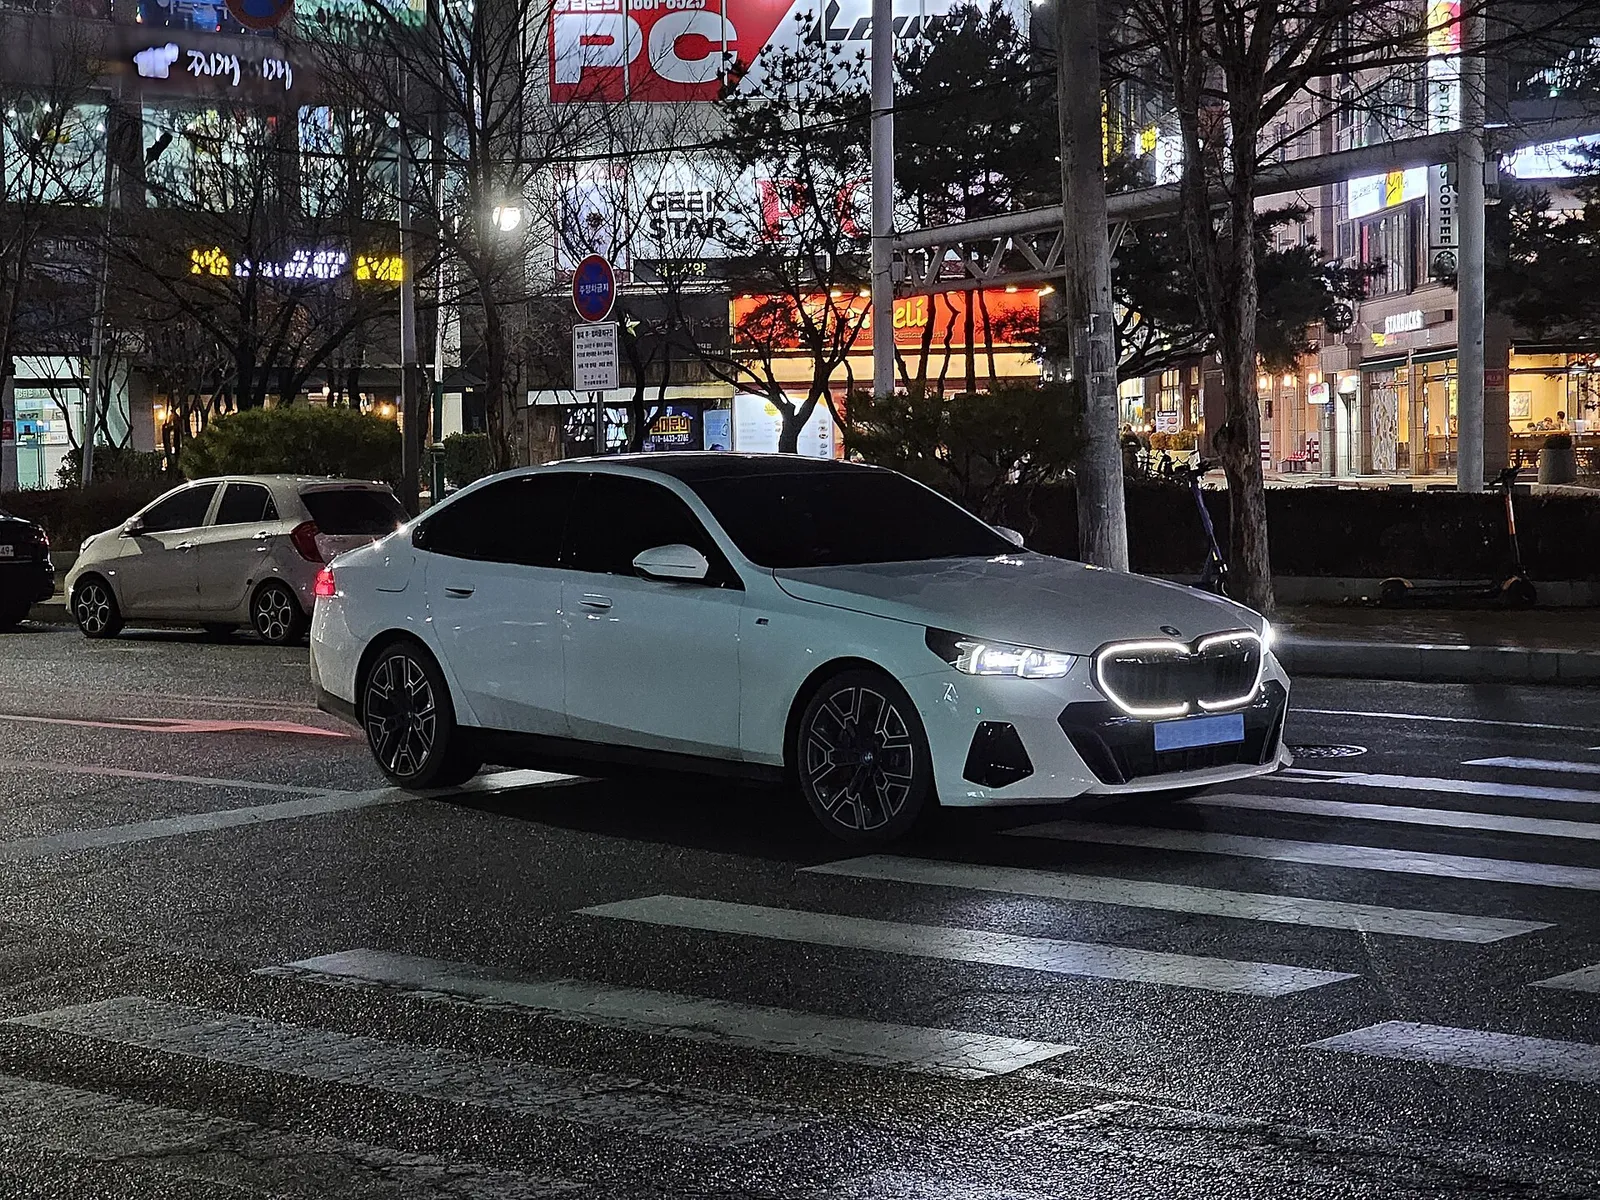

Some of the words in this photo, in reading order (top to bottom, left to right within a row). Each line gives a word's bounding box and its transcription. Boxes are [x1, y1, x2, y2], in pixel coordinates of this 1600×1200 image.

[553, 10, 739, 84] PC
[648, 191, 725, 213] GEEK
[1439, 185, 1451, 244] COFFEE
[649, 218, 728, 240] STAR
[579, 283, 609, 295] 주정차금지
[1385, 310, 1423, 334] STARBUCKS
